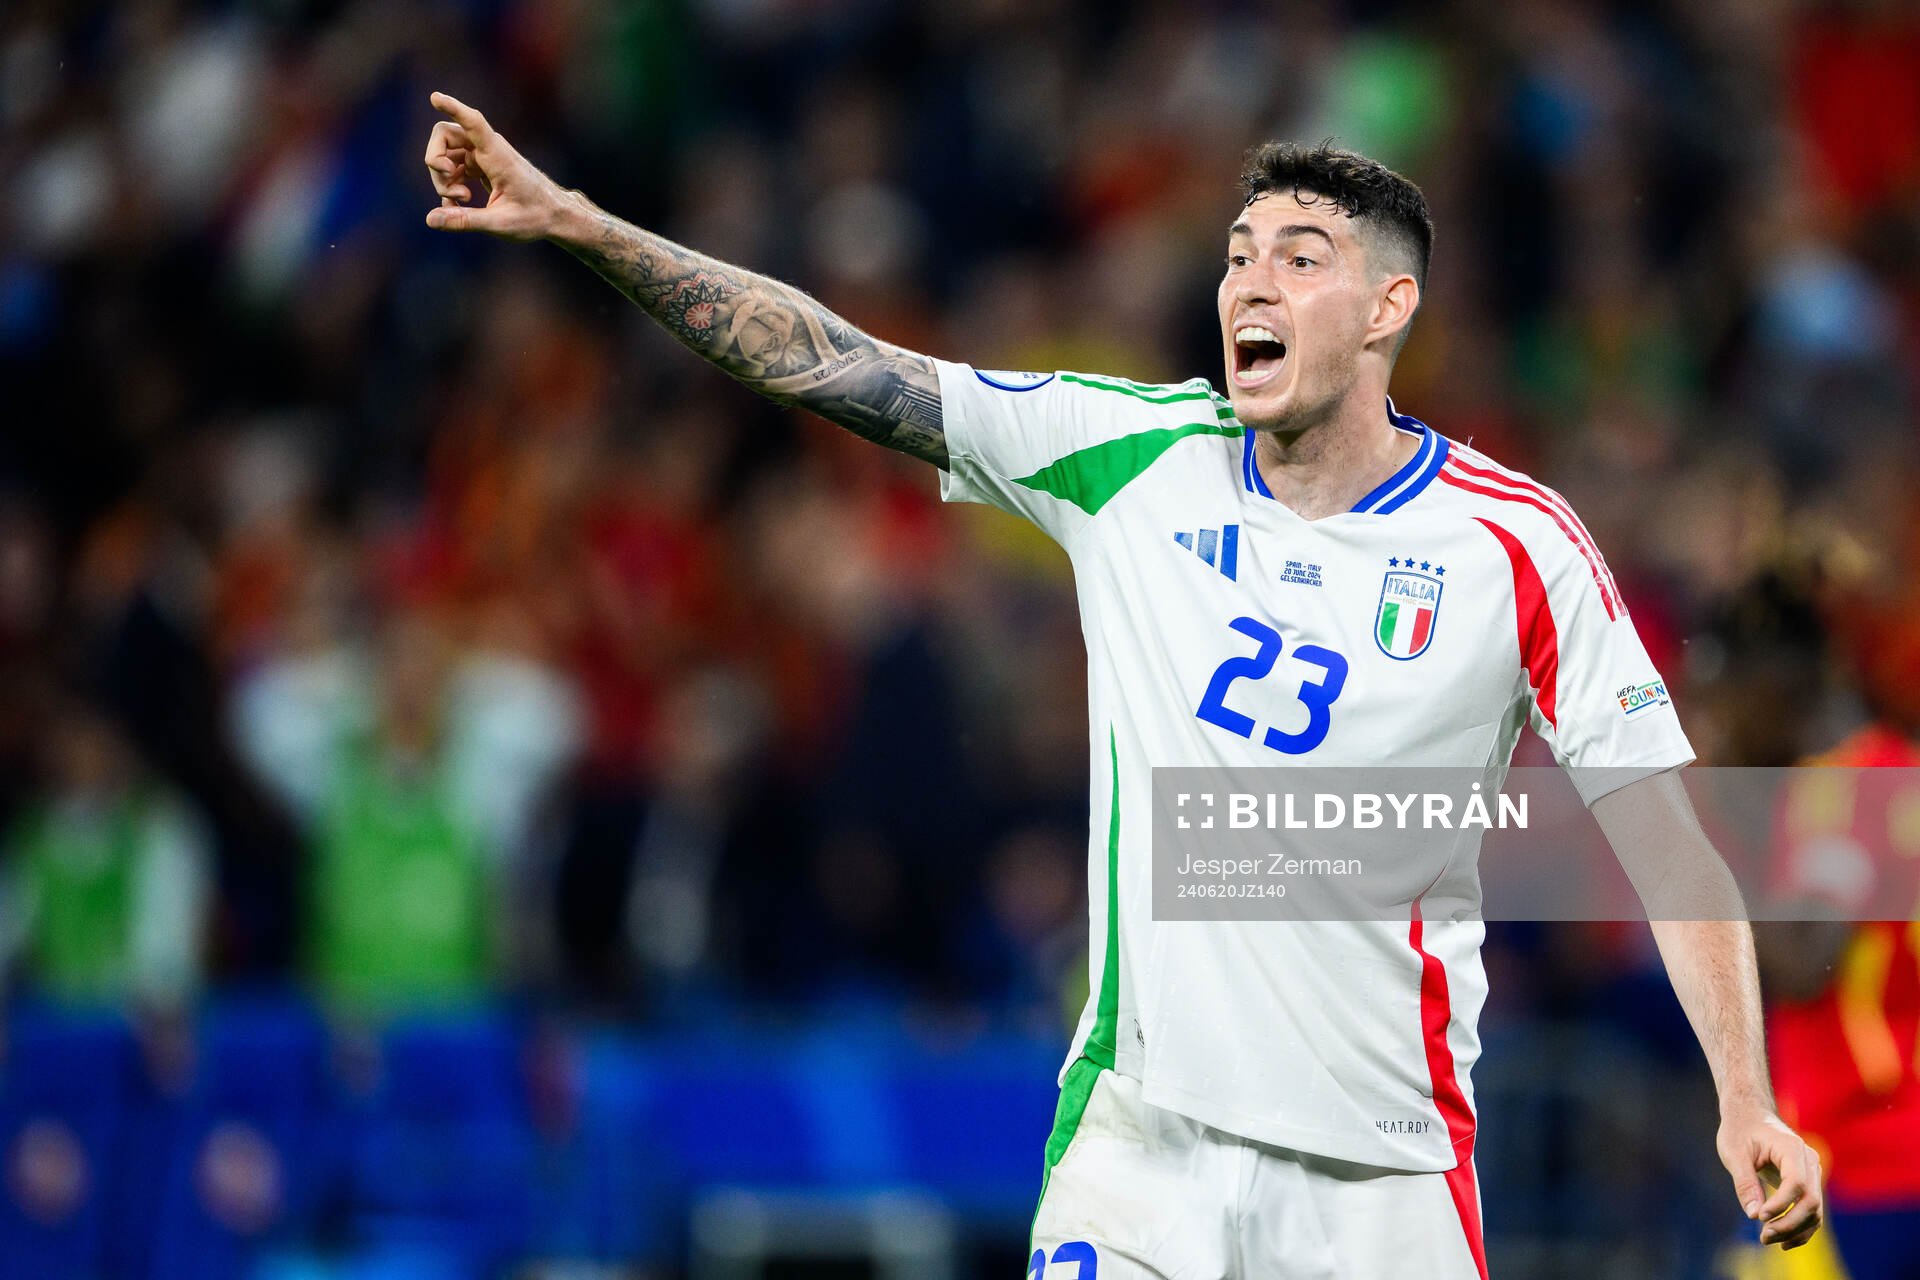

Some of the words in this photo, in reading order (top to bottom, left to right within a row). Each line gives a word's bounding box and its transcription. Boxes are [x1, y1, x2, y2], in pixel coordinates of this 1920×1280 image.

[1286, 560, 1302, 569] SPAIN
[1284, 567, 1292, 575] 20
[1293, 569, 1306, 577] JUNE
[1307, 571, 1321, 579] 2024
[1280, 574, 1323, 587] GELSENKIRCHEN
[1387, 577, 1435, 601] ITALIA
[1195, 616, 1349, 755] 23
[1616, 685, 1637, 699] UEFA
